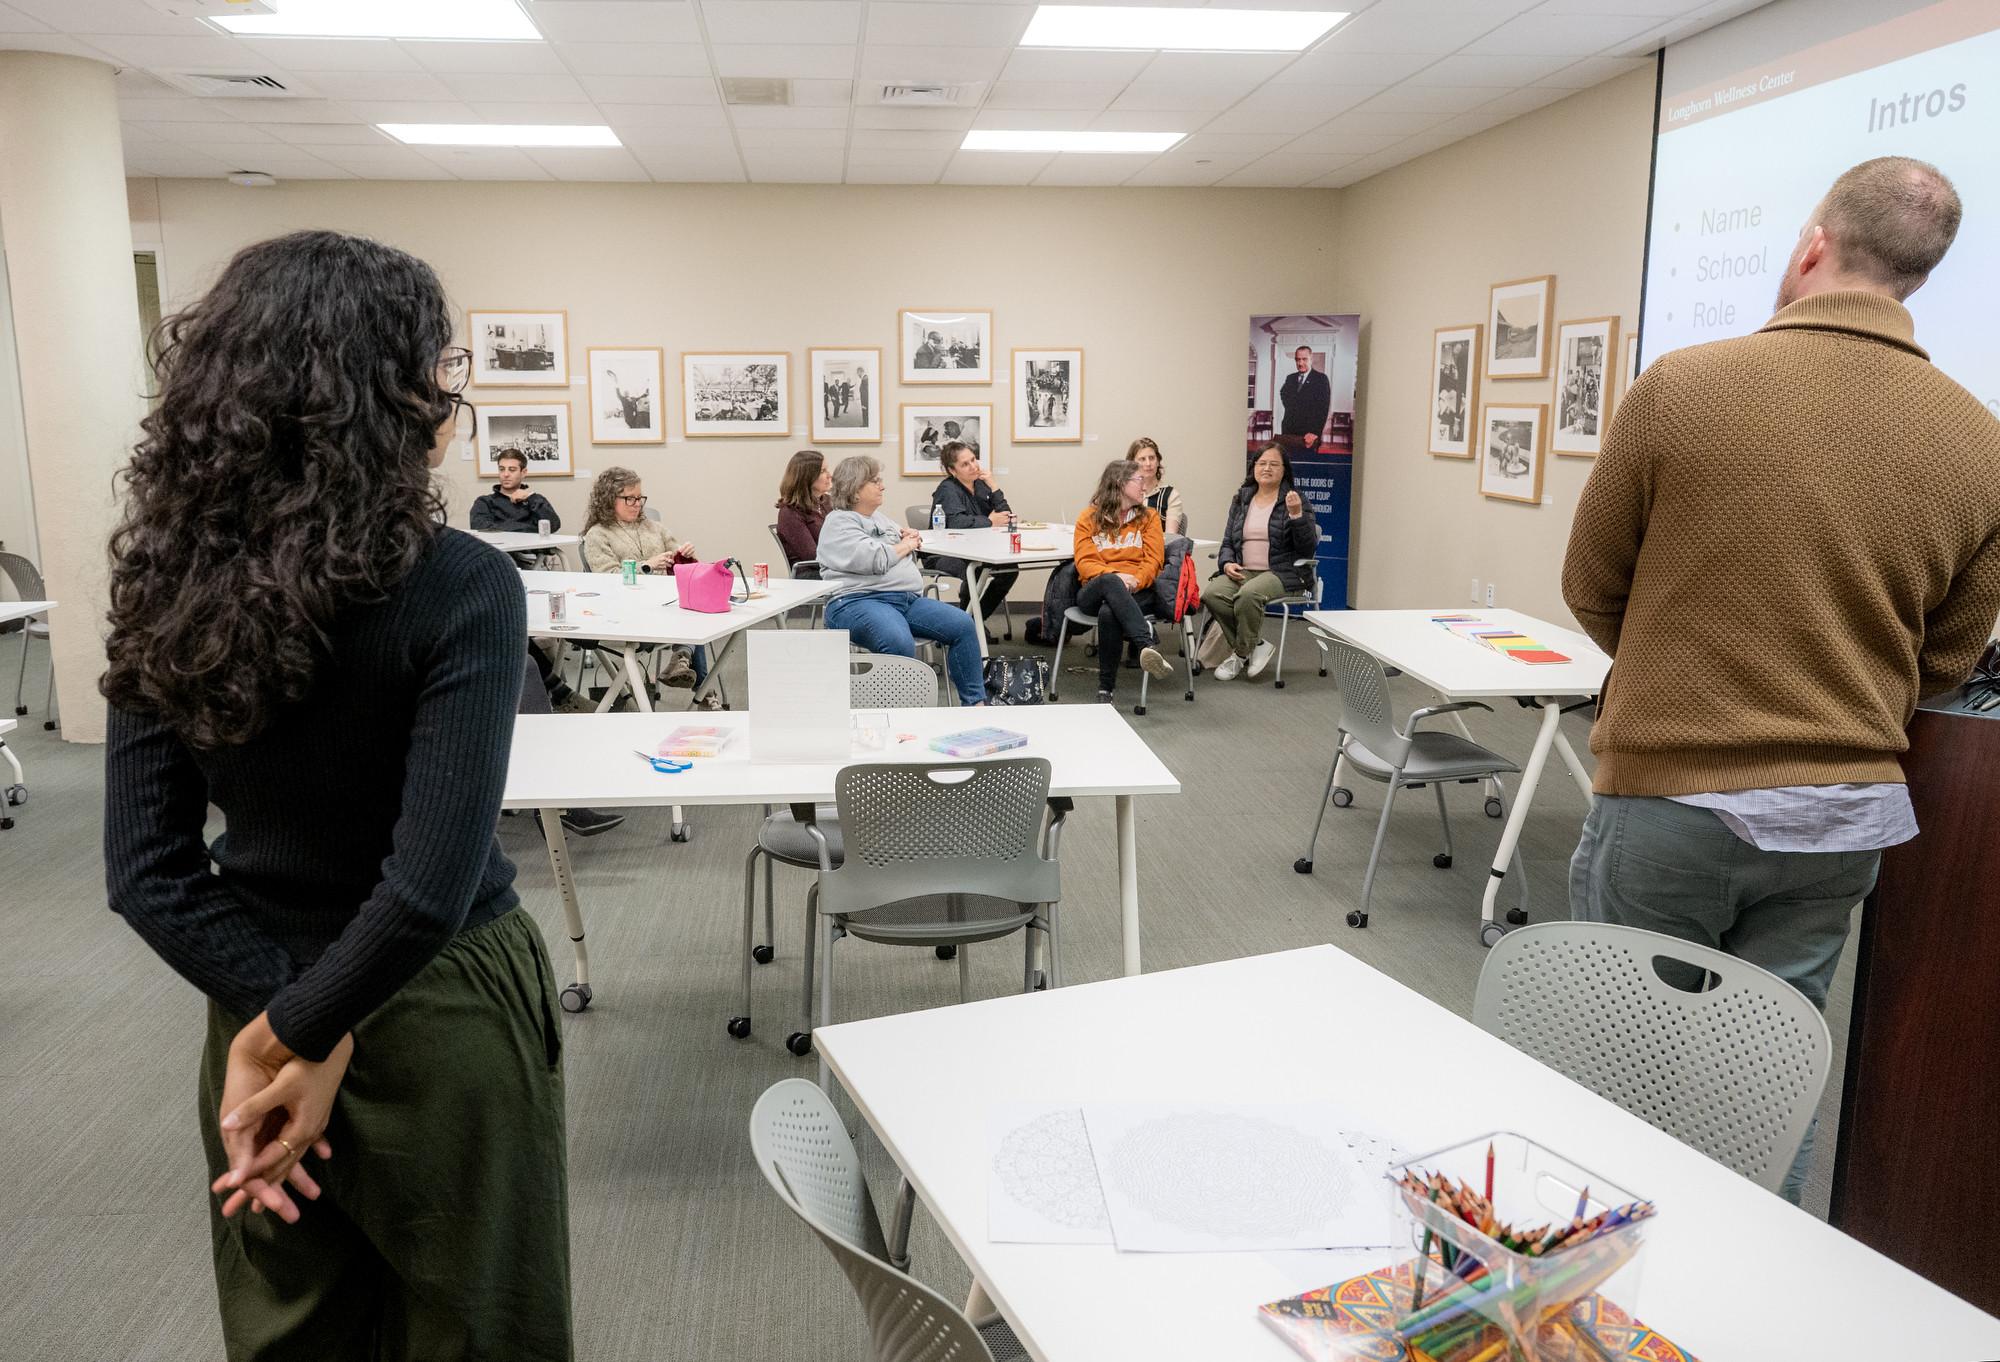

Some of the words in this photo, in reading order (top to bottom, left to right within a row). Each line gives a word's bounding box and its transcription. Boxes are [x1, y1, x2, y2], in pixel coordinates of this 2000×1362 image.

[1668, 98, 1712, 121] Longhorn
[1714, 82, 1757, 107] Wellness
[1759, 70, 1796, 92] Center
[1868, 83, 1967, 133] Intros
[1701, 205, 1761, 236] Name
[1697, 245, 1767, 282] School
[1693, 299, 1735, 328] Role
[1301, 478, 1310, 487] THE
[1310, 478, 1327, 488] DOORS
[1327, 479, 1334, 488] OF
[1316, 491, 1331, 501] EQUIP
